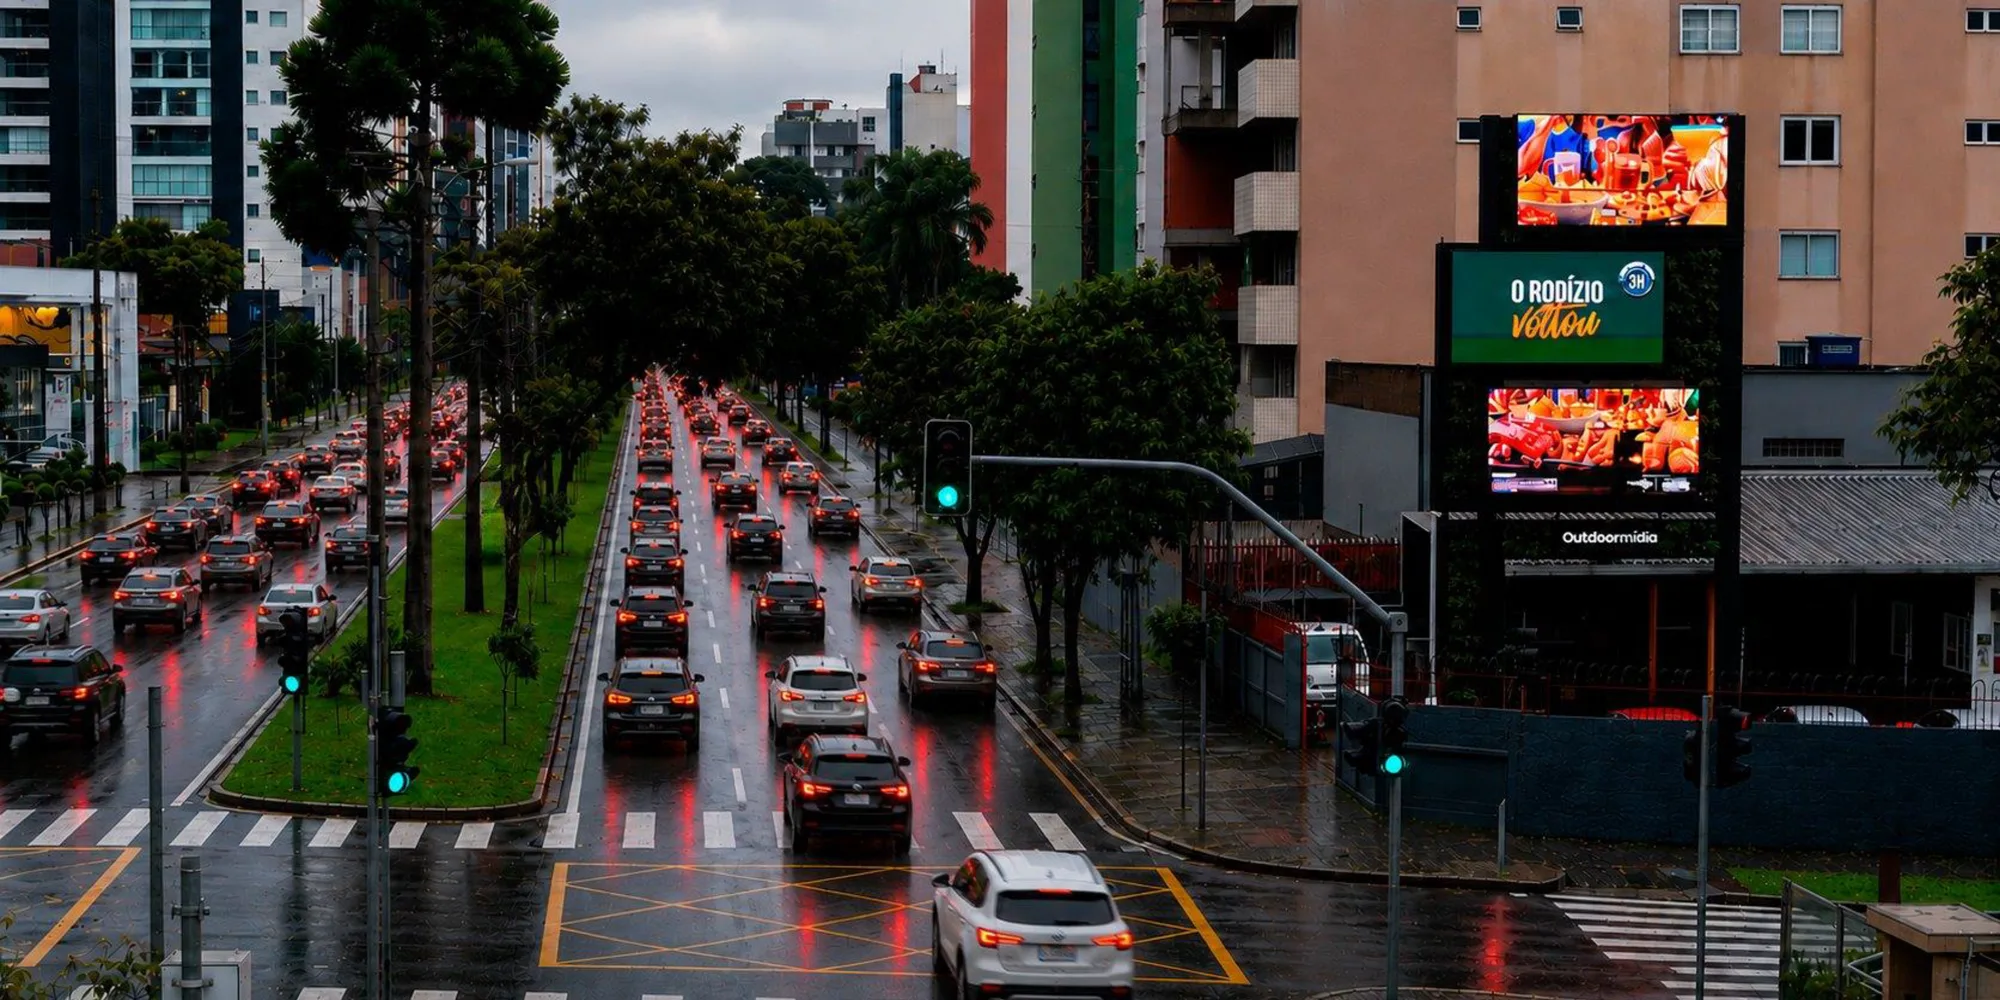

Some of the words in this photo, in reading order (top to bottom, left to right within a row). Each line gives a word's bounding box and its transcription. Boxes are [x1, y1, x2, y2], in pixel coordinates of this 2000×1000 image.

[1511, 279, 1524, 303] O
[1529, 274, 1604, 303] RODÍZIO
[1628, 274, 1645, 290] 3H
